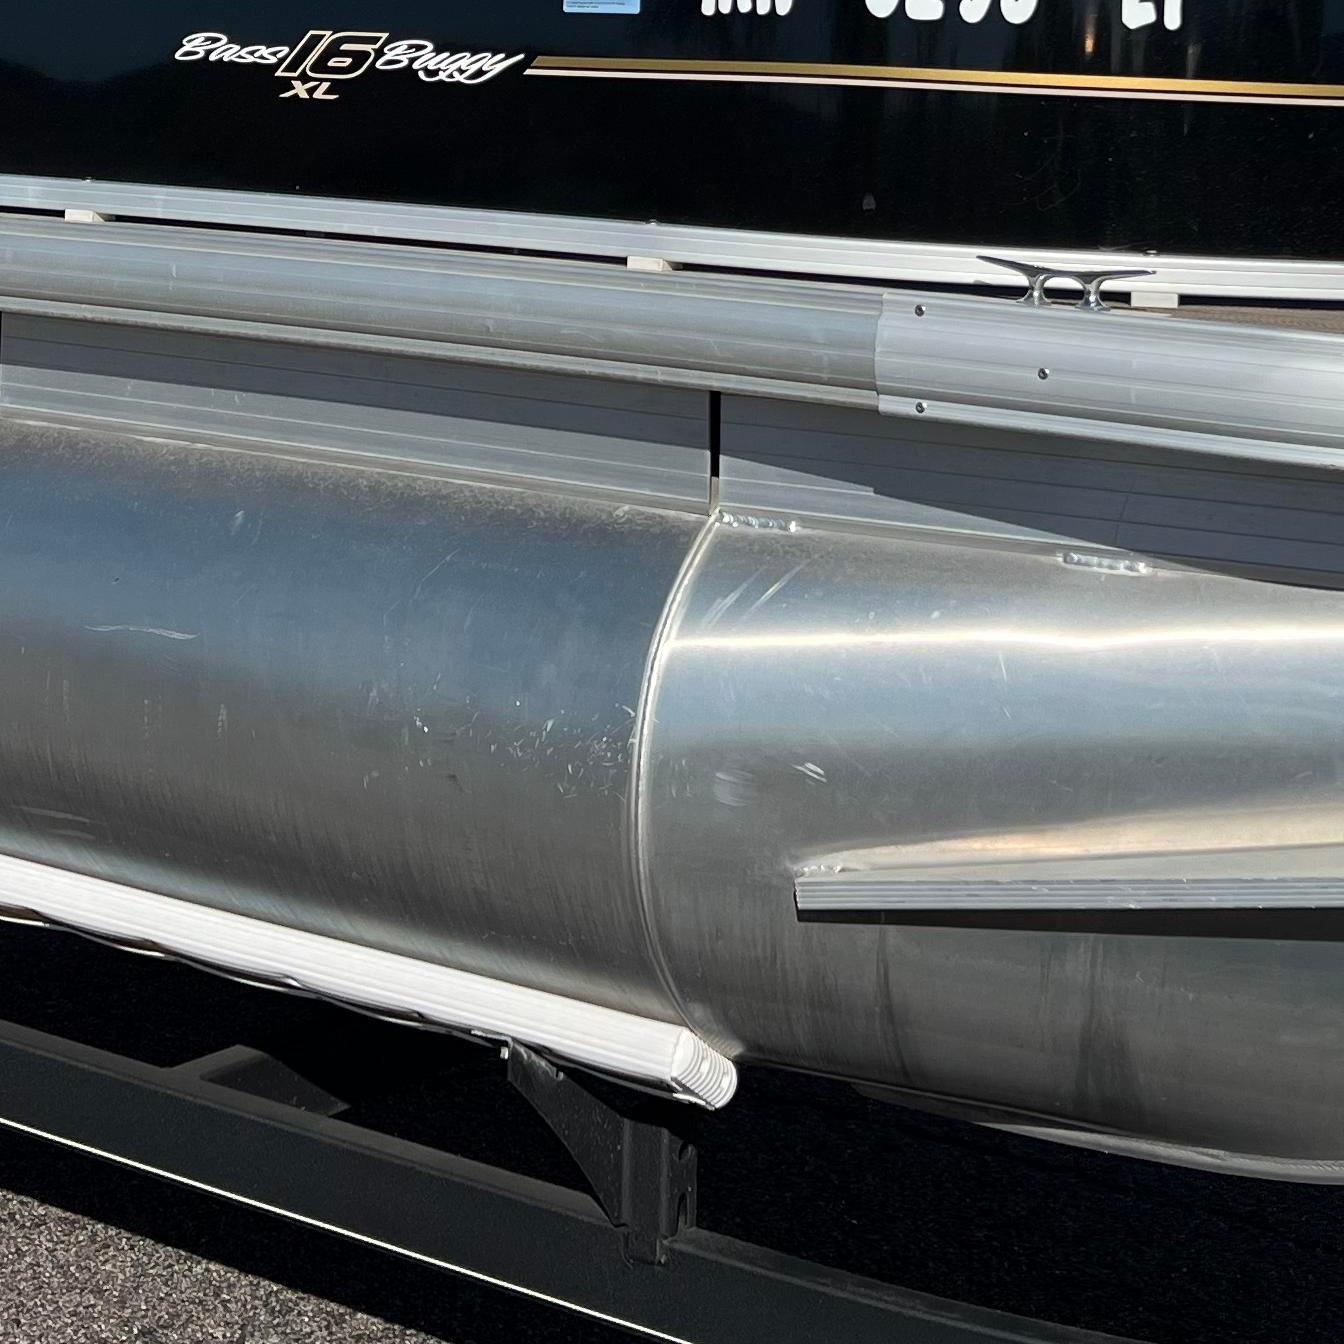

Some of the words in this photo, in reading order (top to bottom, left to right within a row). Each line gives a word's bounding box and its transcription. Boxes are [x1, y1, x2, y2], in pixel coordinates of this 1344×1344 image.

[174, 31, 290, 64] Bass
[274, 30, 390, 79] 16
[375, 39, 526, 84] Buggy
[279, 81, 339, 100] XL
